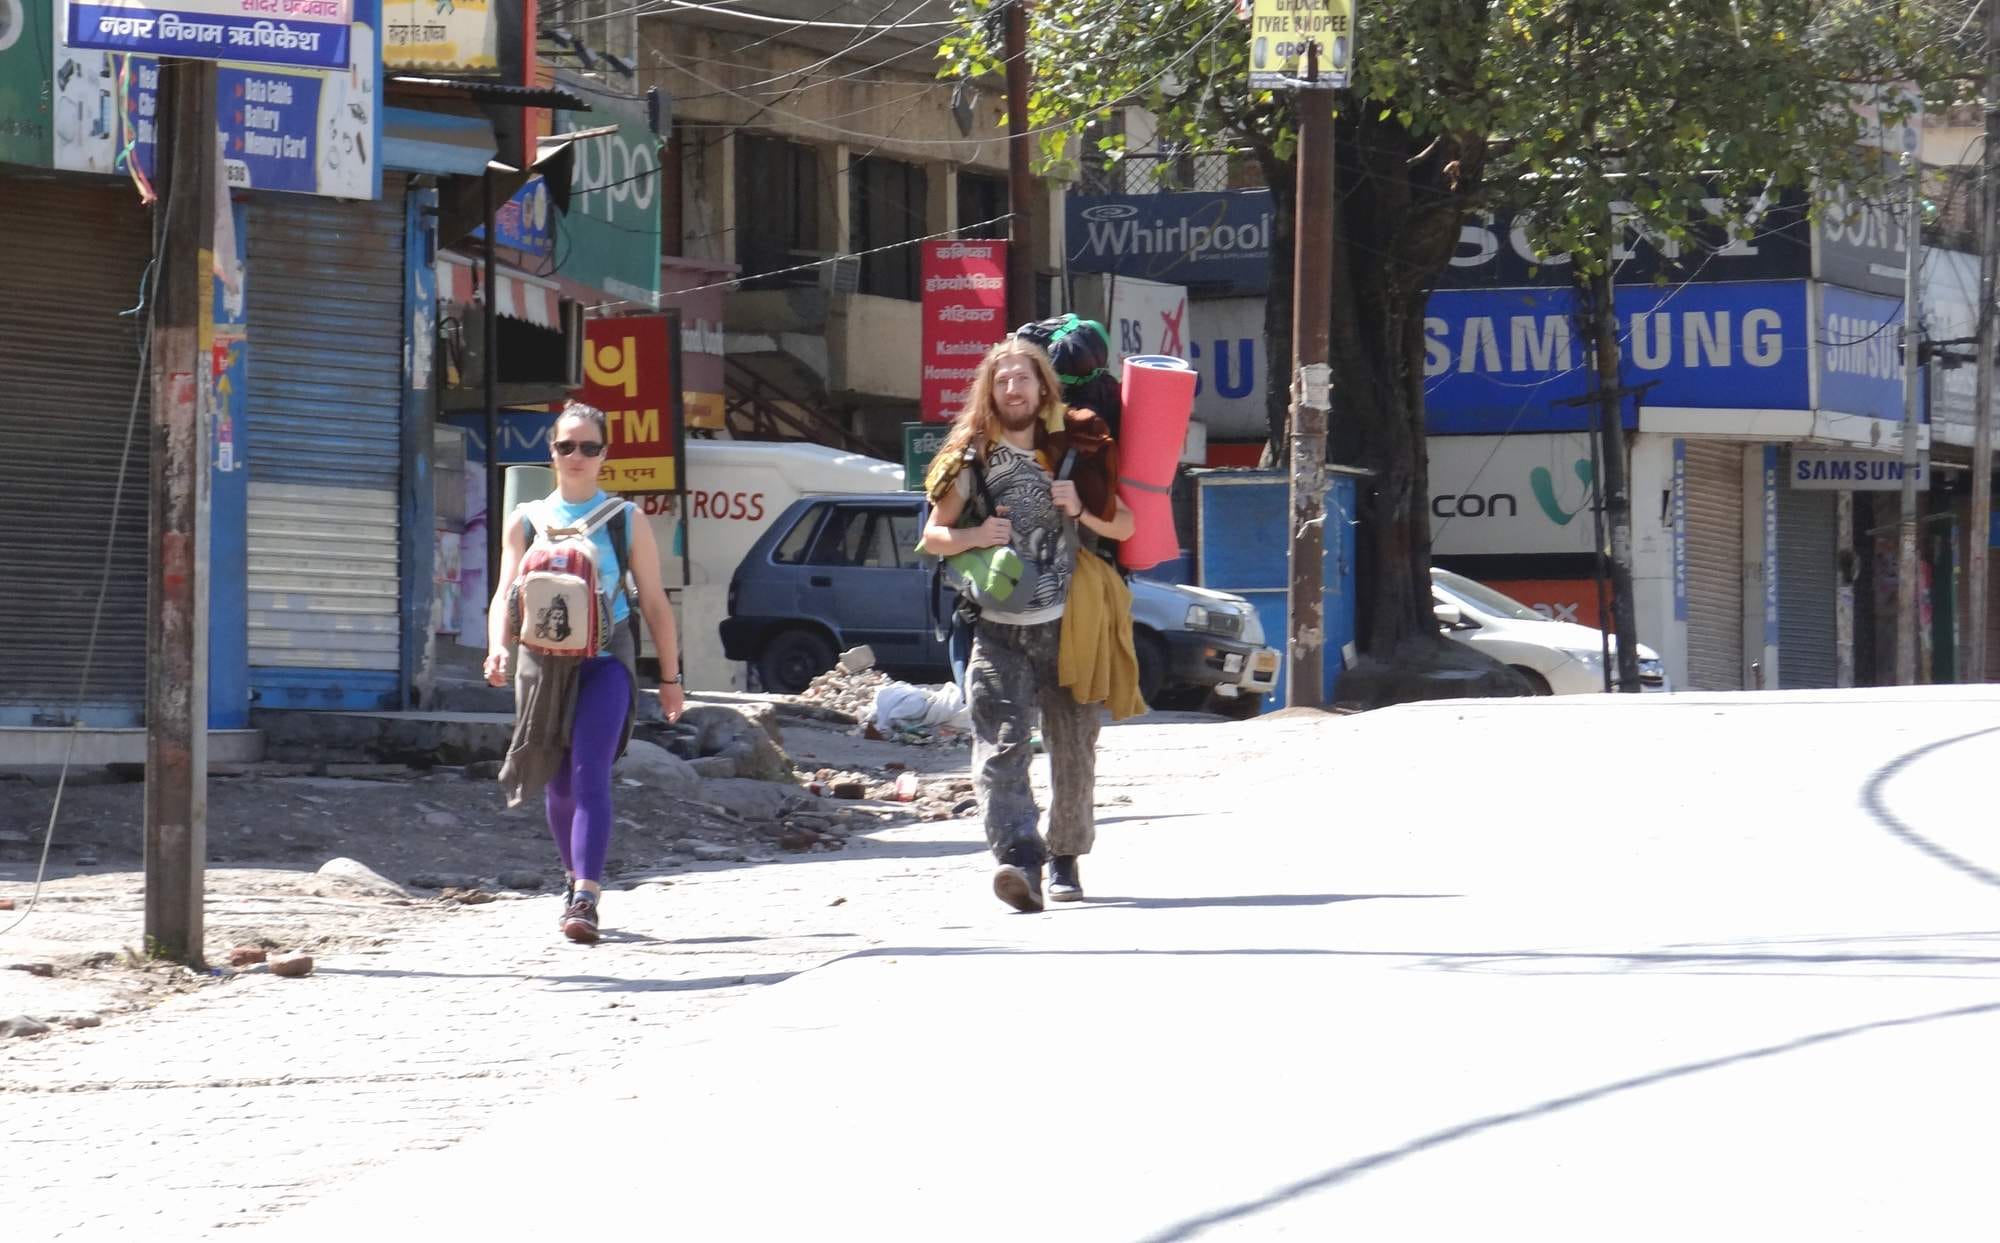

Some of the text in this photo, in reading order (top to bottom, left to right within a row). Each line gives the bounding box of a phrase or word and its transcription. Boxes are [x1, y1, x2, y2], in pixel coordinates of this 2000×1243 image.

[99, 13, 320, 51] नगर निगम ऋषिकेश
[1257, 16, 1289, 32] TYRE
[1088, 213, 1268, 262] Whirlpool
[936, 341, 993, 355] Kanishka
[1423, 308, 1783, 377] SAMUNG
[606, 409, 660, 444] TM
[623, 467, 656, 482] एम
[1797, 460, 1920, 481] SAMSUN
[1432, 493, 1517, 518] con
